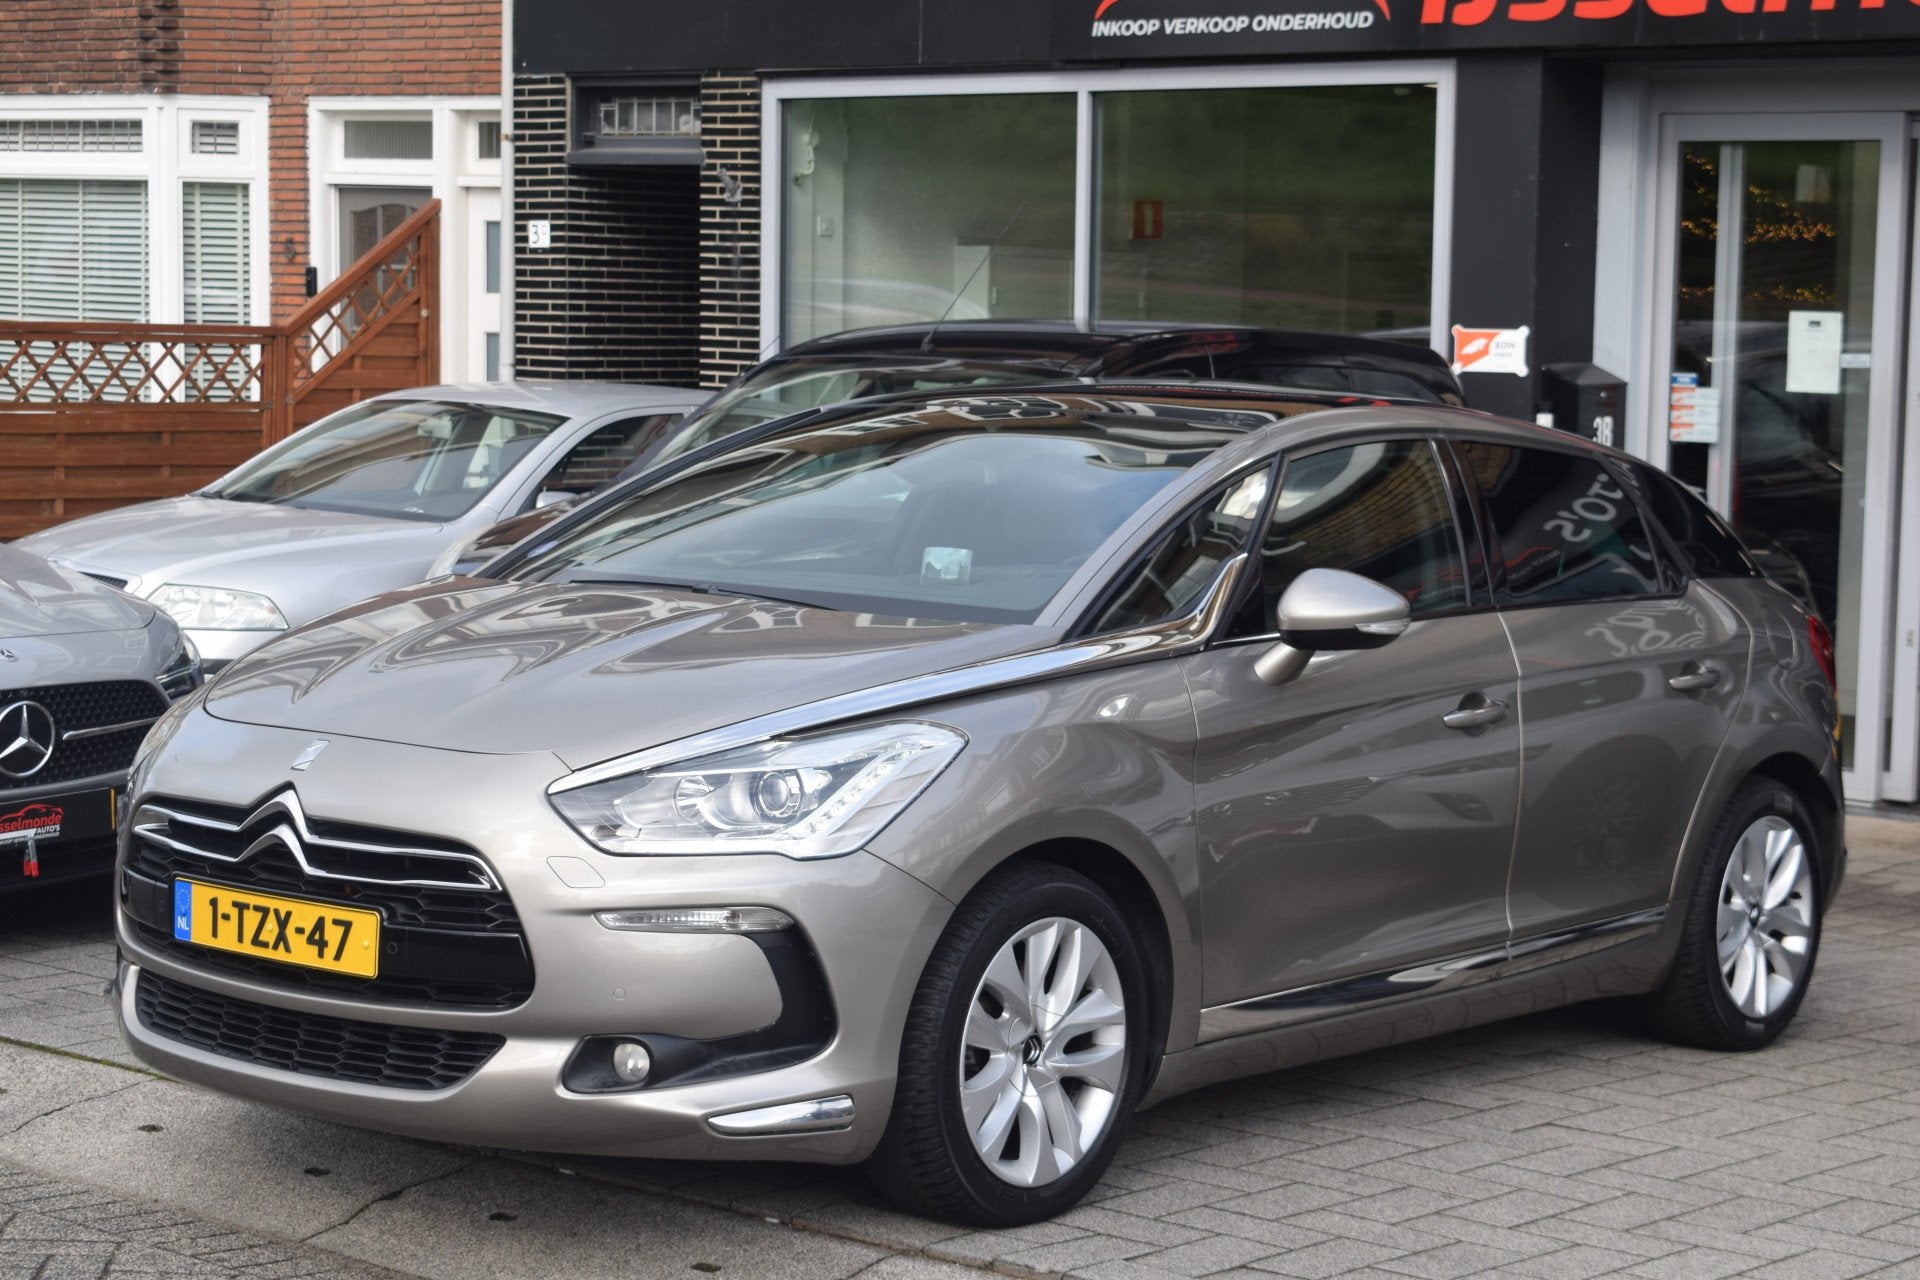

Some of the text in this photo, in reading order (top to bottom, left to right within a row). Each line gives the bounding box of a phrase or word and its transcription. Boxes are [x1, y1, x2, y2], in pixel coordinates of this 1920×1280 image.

[1091, 11, 1373, 38] INKOOP VERKOOP ONDERHOUD
[177, 915, 190, 931] NL
[209, 897, 353, 961] 1-TZX-47
